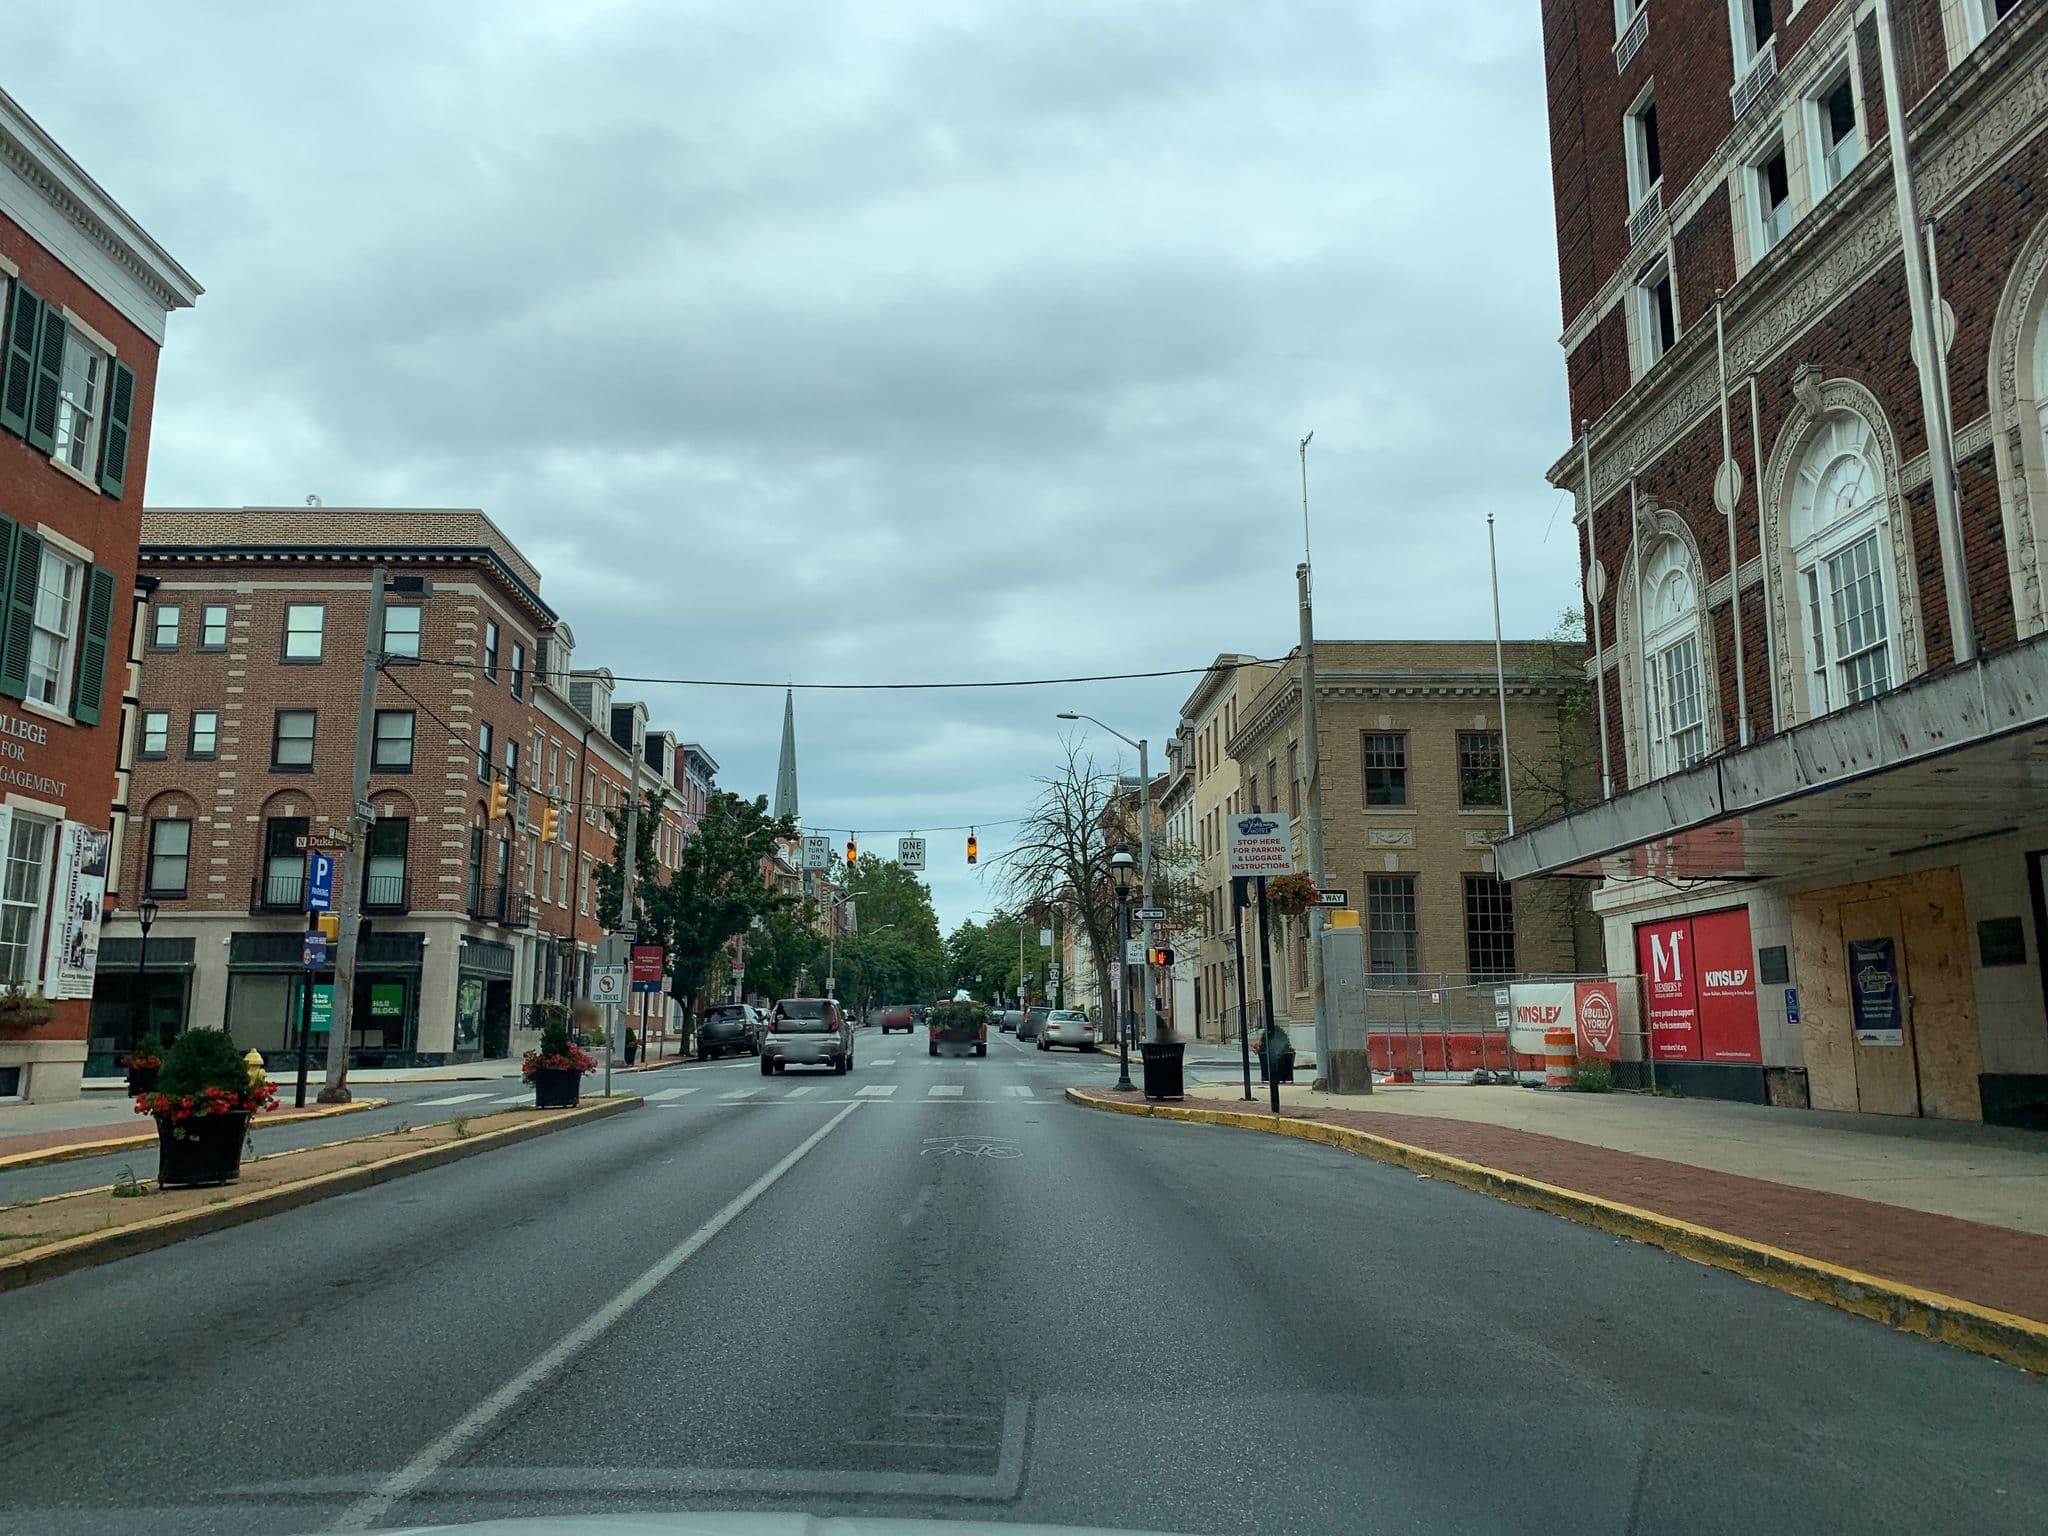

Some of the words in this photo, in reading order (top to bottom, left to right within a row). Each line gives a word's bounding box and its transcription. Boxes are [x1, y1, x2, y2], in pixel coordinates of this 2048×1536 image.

[0, 714, 48, 745] LLEGE
[1, 740, 25, 762] FOR
[310, 836, 334, 847] Duke
[902, 841, 922, 850] ONE
[902, 851, 922, 860] WAY
[1245, 854, 1282, 862] LUGGAGE
[316, 857, 329, 886] P
[1231, 862, 1290, 870] INSTRUCTIONS
[69, 870, 79, 912] HIDDEN
[1325, 894, 1343, 902] WAY
[1705, 969, 1748, 987] KINSLEY
[1655, 982, 1677, 993] MEMBERS
[372, 1007, 400, 1015] BLOCK
[1516, 1006, 1562, 1024] KINSLEY
[1587, 1019, 1607, 1029] YORK
